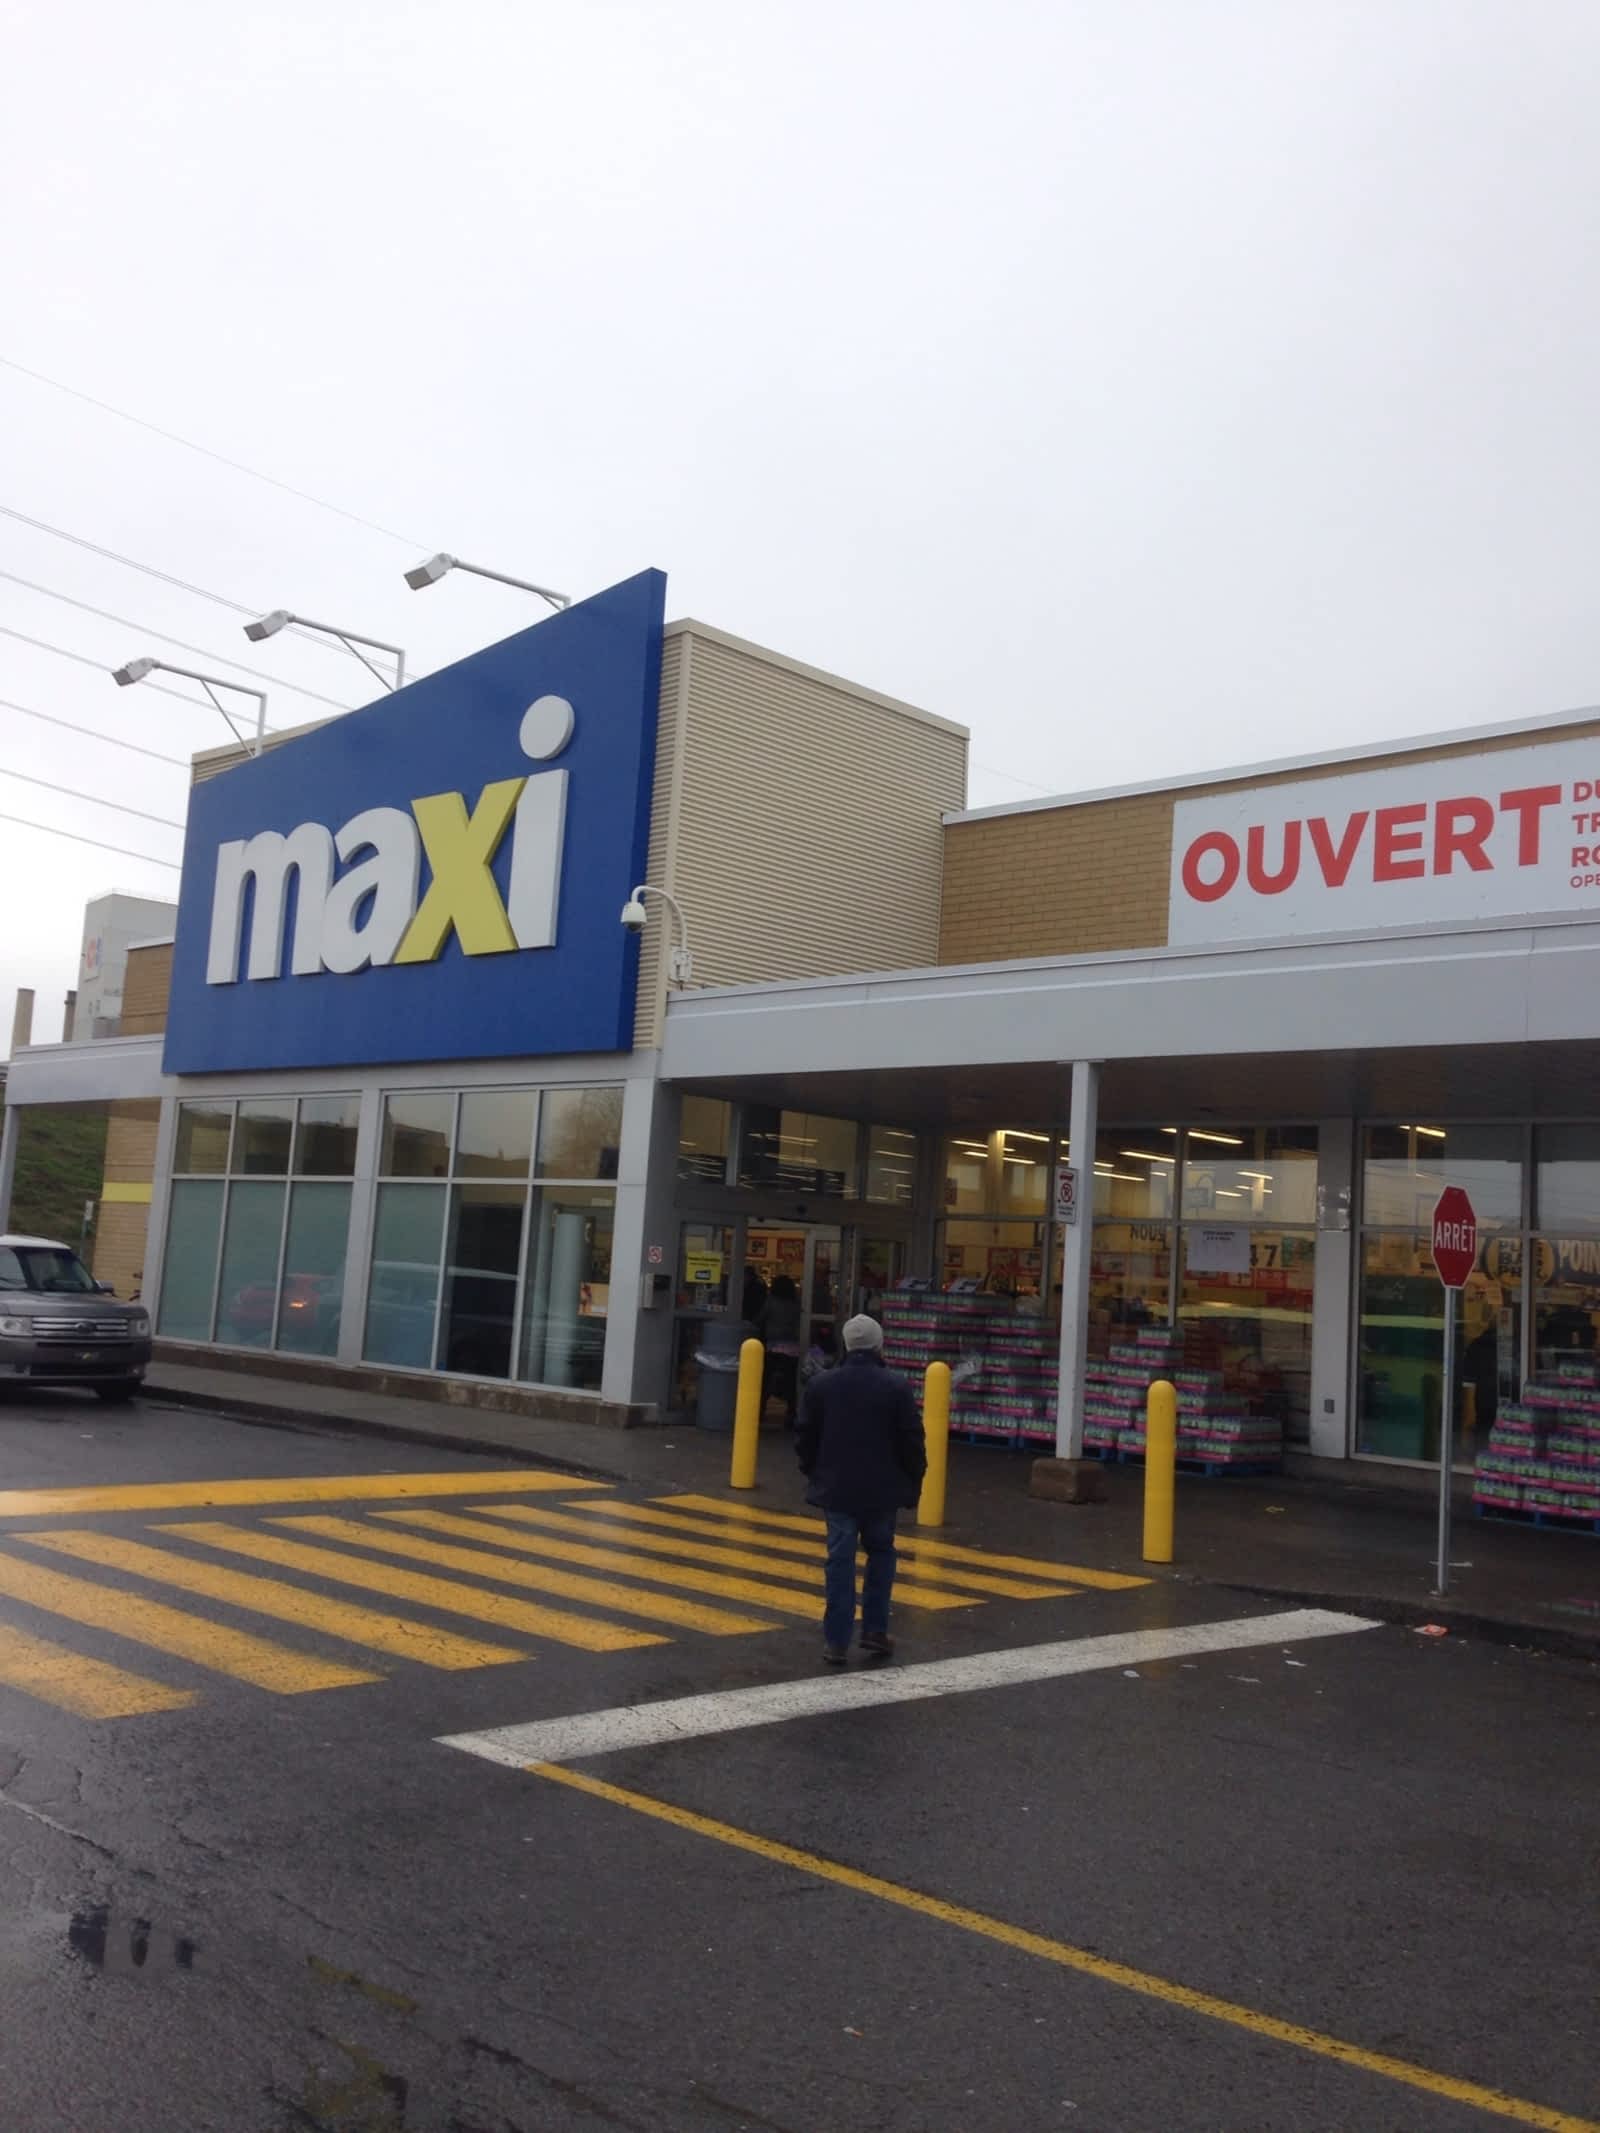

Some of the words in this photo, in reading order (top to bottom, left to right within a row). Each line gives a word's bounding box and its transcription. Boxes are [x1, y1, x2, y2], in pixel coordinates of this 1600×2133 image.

[206, 695, 575, 985] maxi
[1181, 784, 1562, 902] OUVERT
[1434, 1219, 1475, 1252] ARRÊT
